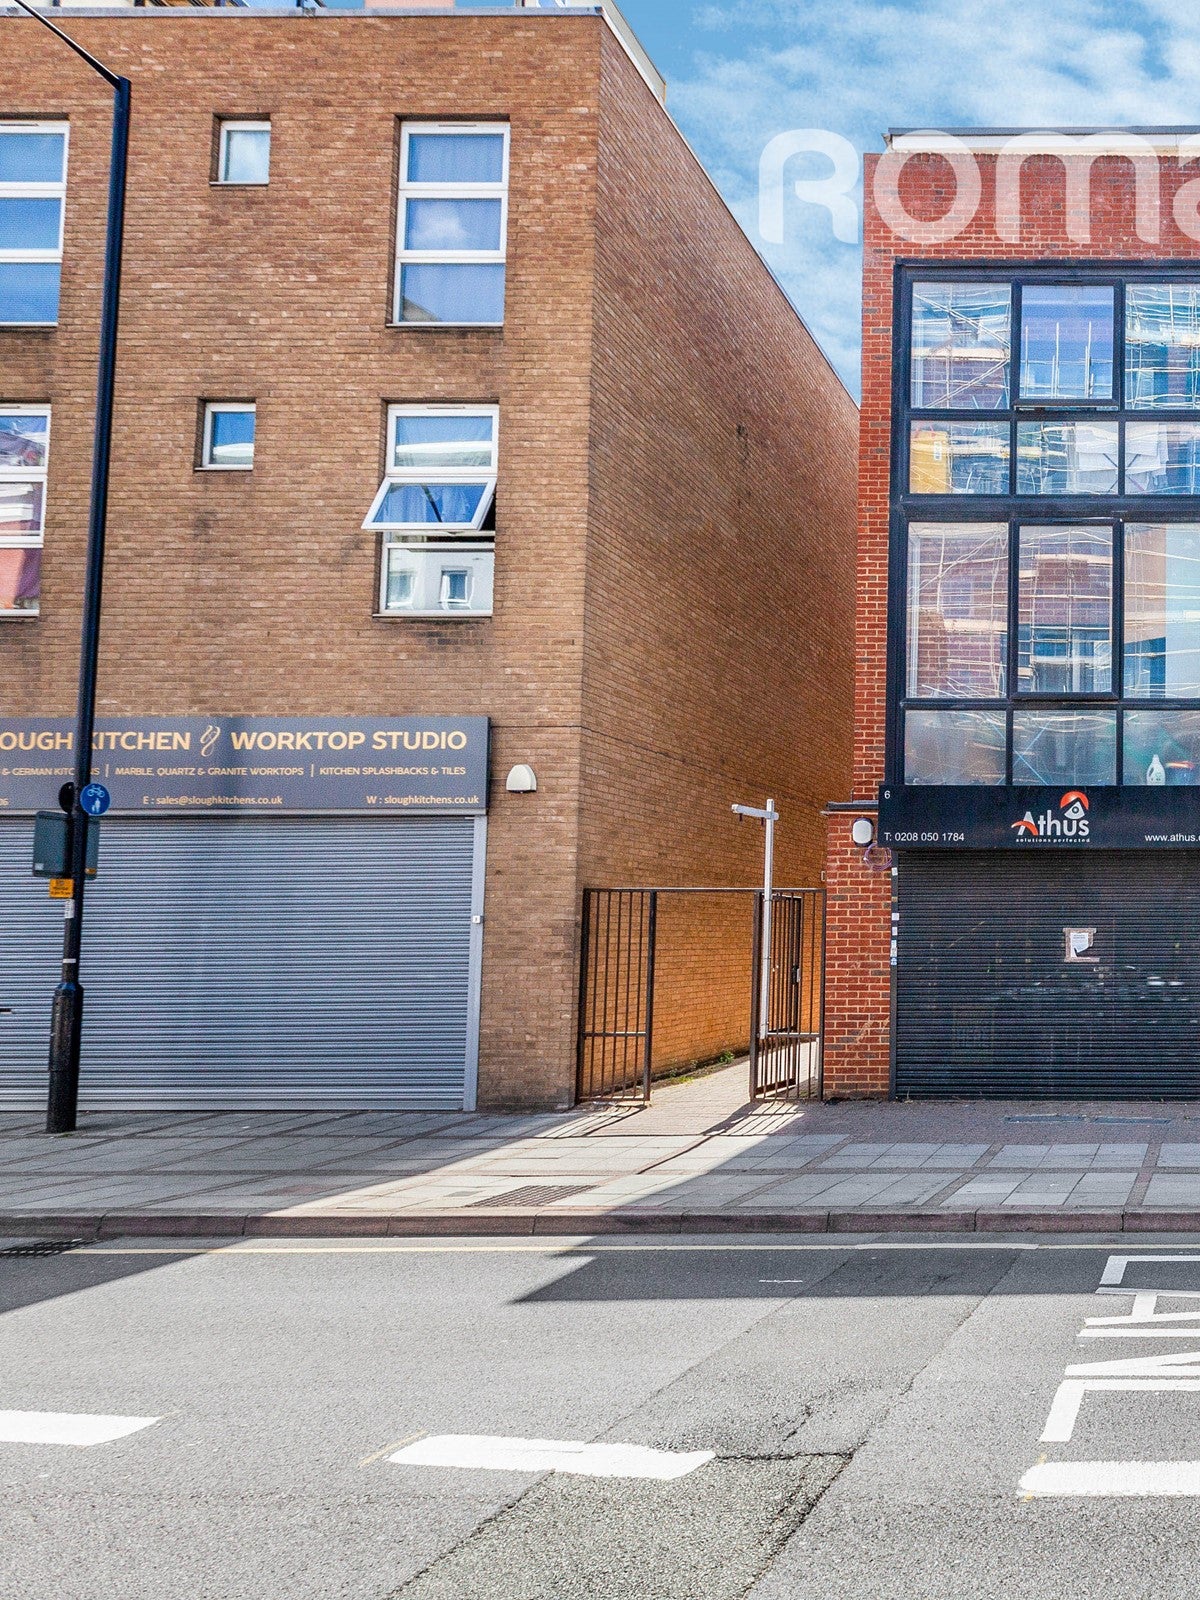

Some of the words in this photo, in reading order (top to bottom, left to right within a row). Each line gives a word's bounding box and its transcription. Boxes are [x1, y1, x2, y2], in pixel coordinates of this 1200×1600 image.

[231, 731, 365, 750] WORKTOP
[372, 731, 467, 750] STUDIO
[12, 767, 52, 776] GERMAN
[157, 767, 195, 777] QUARTZ
[208, 767, 247, 776] GRANITE
[250, 767, 304, 776] WORKTOPS
[319, 766, 360, 775] KITCHEN
[362, 766, 429, 776] SPLASHBACKS
[441, 766, 466, 775] TILES
[884, 790, 891, 799] 6
[156, 795, 283, 806] sales@sloughkitchens.co.uk
[384, 795, 479, 806] sloughkitchens.co.uk
[1011, 809, 1090, 836] Athus
[884, 832, 892, 842] T:
[894, 832, 917, 842] 0208
[921, 832, 939, 842] 050
[941, 832, 965, 842] 1784
